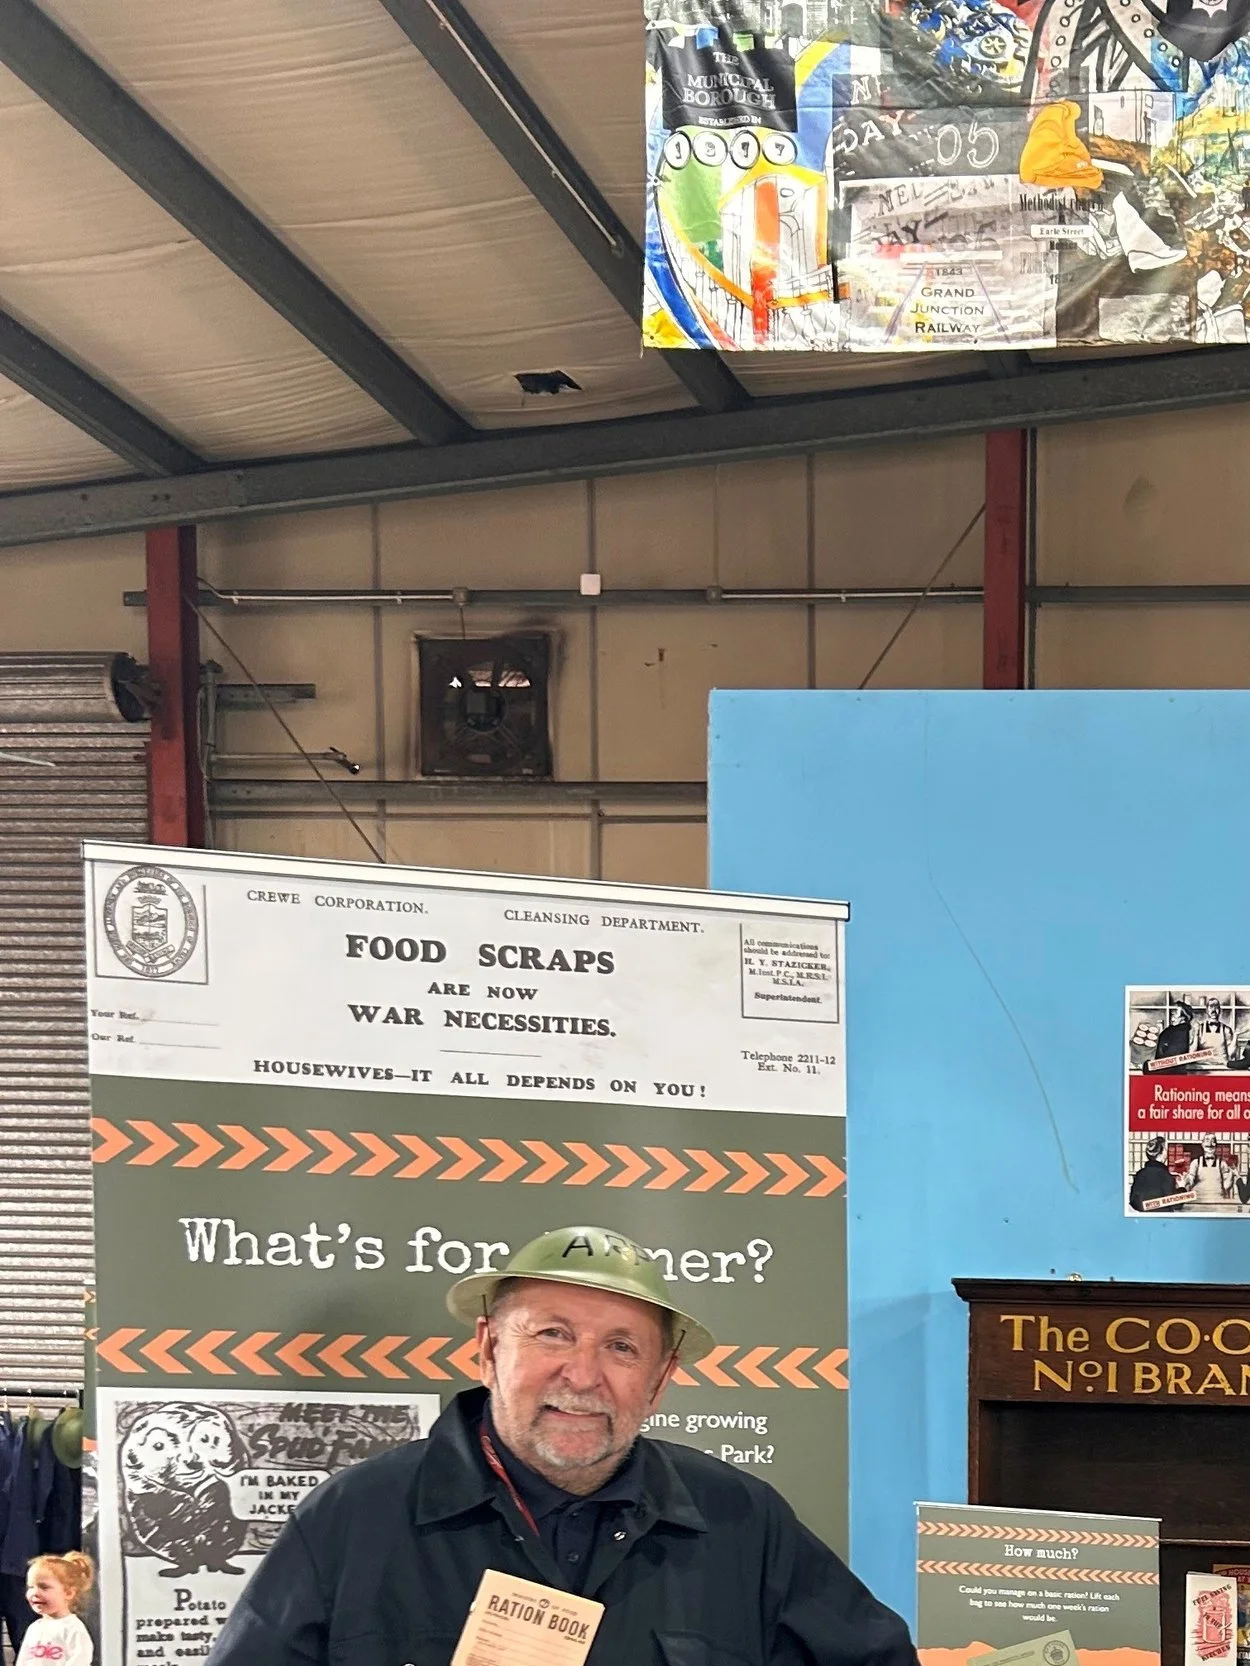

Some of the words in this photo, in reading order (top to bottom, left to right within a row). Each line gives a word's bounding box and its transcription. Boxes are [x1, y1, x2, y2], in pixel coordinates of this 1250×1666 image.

[713, 52, 739, 66] THE
[688, 74, 774, 92] MUNICIPAL
[682, 88, 776, 110] BOROUGH
[1040, 227, 1059, 236] Earle
[1062, 227, 1084, 236] Street
[936, 268, 962, 276] 1843
[921, 287, 975, 298] GRAND
[910, 303, 984, 315] JUNCTION
[915, 322, 981, 333] RAILWAY
[247, 890, 300, 905] CREWE
[315, 895, 428, 914] CORPORATION.
[504, 909, 590, 926] CLEANSING
[602, 915, 705, 933] DEPARTMENT.
[345, 933, 447, 964] FOOD
[478, 943, 615, 975] SCRAPS
[428, 981, 471, 996] ARE
[487, 986, 538, 1001] NOW
[348, 1004, 425, 1026] WAR
[444, 1009, 617, 1038] NECESSITIES.
[92, 1033, 111, 1043] Our
[741, 1050, 793, 1063] Telephone
[797, 1054, 836, 1065] 2211-12
[450, 1071, 489, 1086] ALL
[506, 1074, 596, 1091] DEPENDS
[610, 1079, 637, 1094] ON
[1154, 1084, 1210, 1104] Rationing
[1138, 1108, 1146, 1118] a
[1149, 1104, 1170, 1120] fair
[1172, 1105, 1204, 1120] share
[1207, 1104, 1223, 1120] for
[1226, 1105, 1240, 1120] all
[179, 1216, 385, 1273] What's
[405, 1226, 511, 1275] for
[1000, 1314, 1089, 1354] The
[685, 1412, 768, 1435] growing
[721, 1444, 774, 1464] Park?
[267, 1475, 319, 1488] BAKED
[1004, 1544, 1033, 1557] How
[1036, 1547, 1079, 1560] much?
[173, 1589, 226, 1612] Potato
[969, 1599, 983, 1608] bag
[1008, 1600, 1024, 1608] how
[1026, 1601, 1045, 1609] much
[1063, 1603, 1086, 1611] week's
[1088, 1604, 1109, 1612] ration
[136, 1616, 208, 1630] prepared
[488, 1594, 545, 1626] RATION
[548, 1614, 590, 1640] BOOK
[136, 1646, 166, 1658] and
